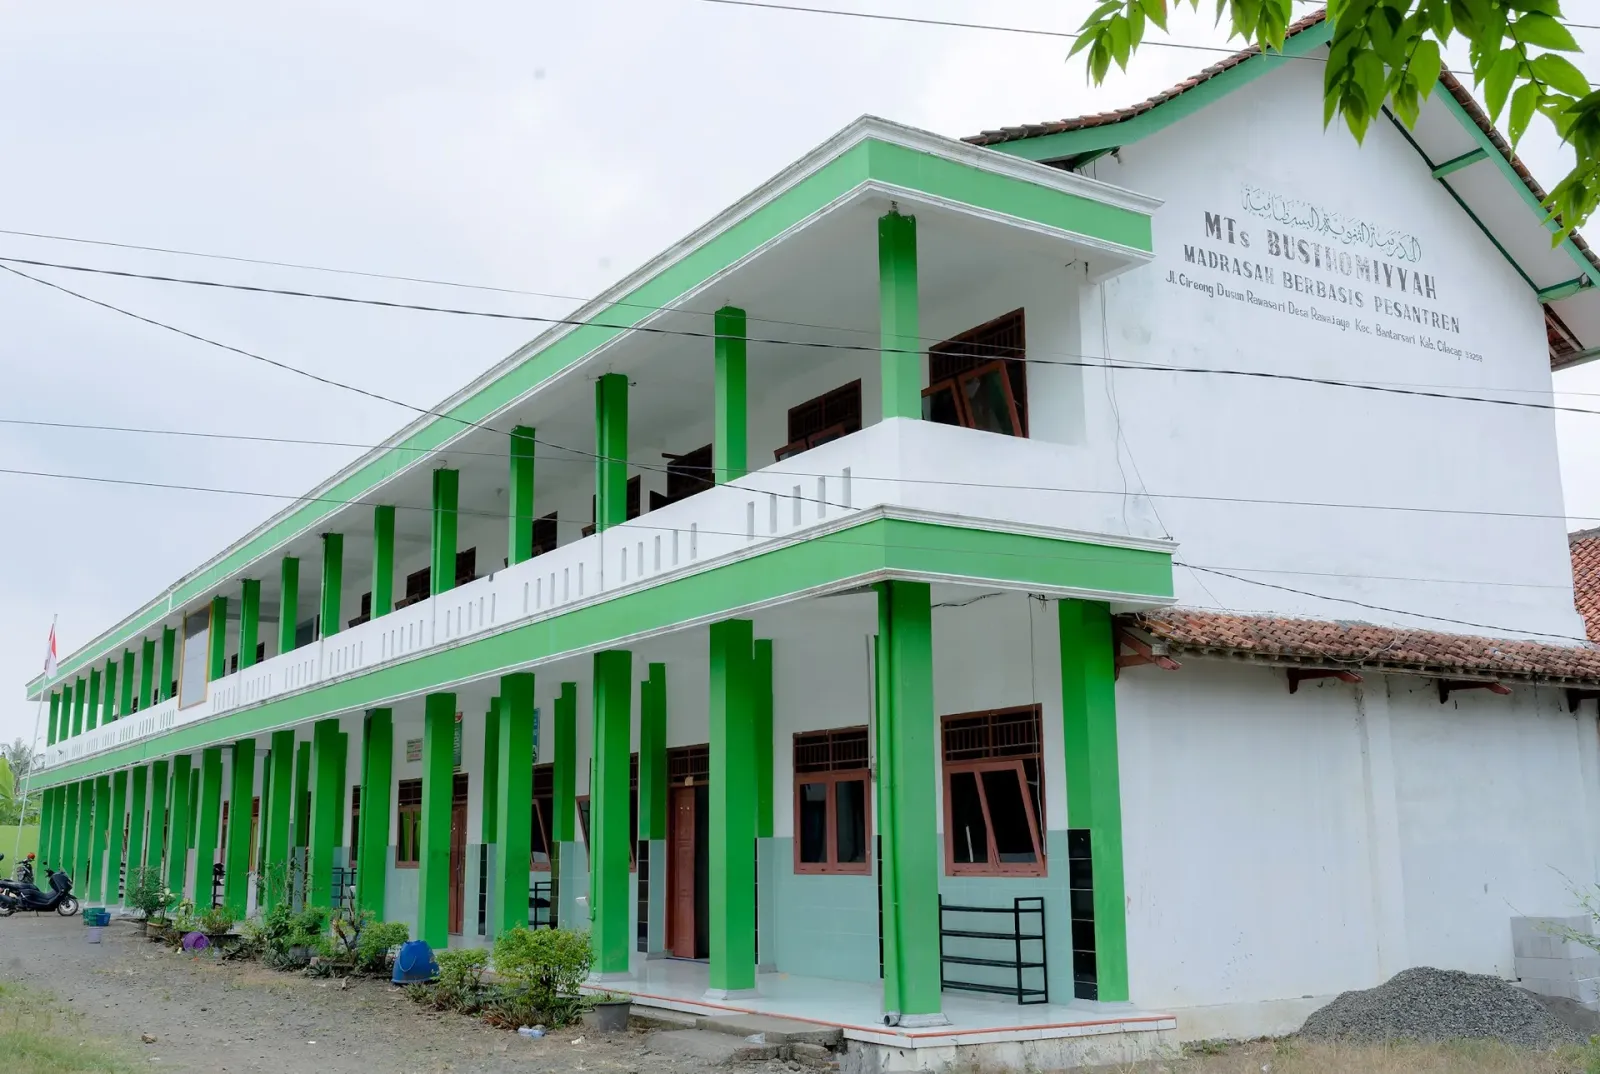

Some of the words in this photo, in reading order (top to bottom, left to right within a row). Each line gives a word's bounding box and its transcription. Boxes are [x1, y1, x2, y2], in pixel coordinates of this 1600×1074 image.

[1184, 244, 1275, 285] MADRASAH
[1282, 271, 1364, 309] BERBASIS
[1374, 295, 1461, 334] PESANTREN
[1204, 211, 1251, 249] MTs
[1266, 229, 1437, 300] BUSTHOMIYYAH
[1165, 270, 1178, 285] Jl.
[1179, 273, 1214, 298] Cireong
[1216, 282, 1245, 301] Dusun
[1246, 290, 1286, 313] Rawasari
[1288, 301, 1309, 318] Desa
[1310, 306, 1350, 331] Rawajaya
[1355, 318, 1373, 334] Kec.
[1375, 323, 1416, 345] Bantarsari
[1419, 335, 1435, 350] Kab.
[1436, 340, 1463, 360] Cilacap
